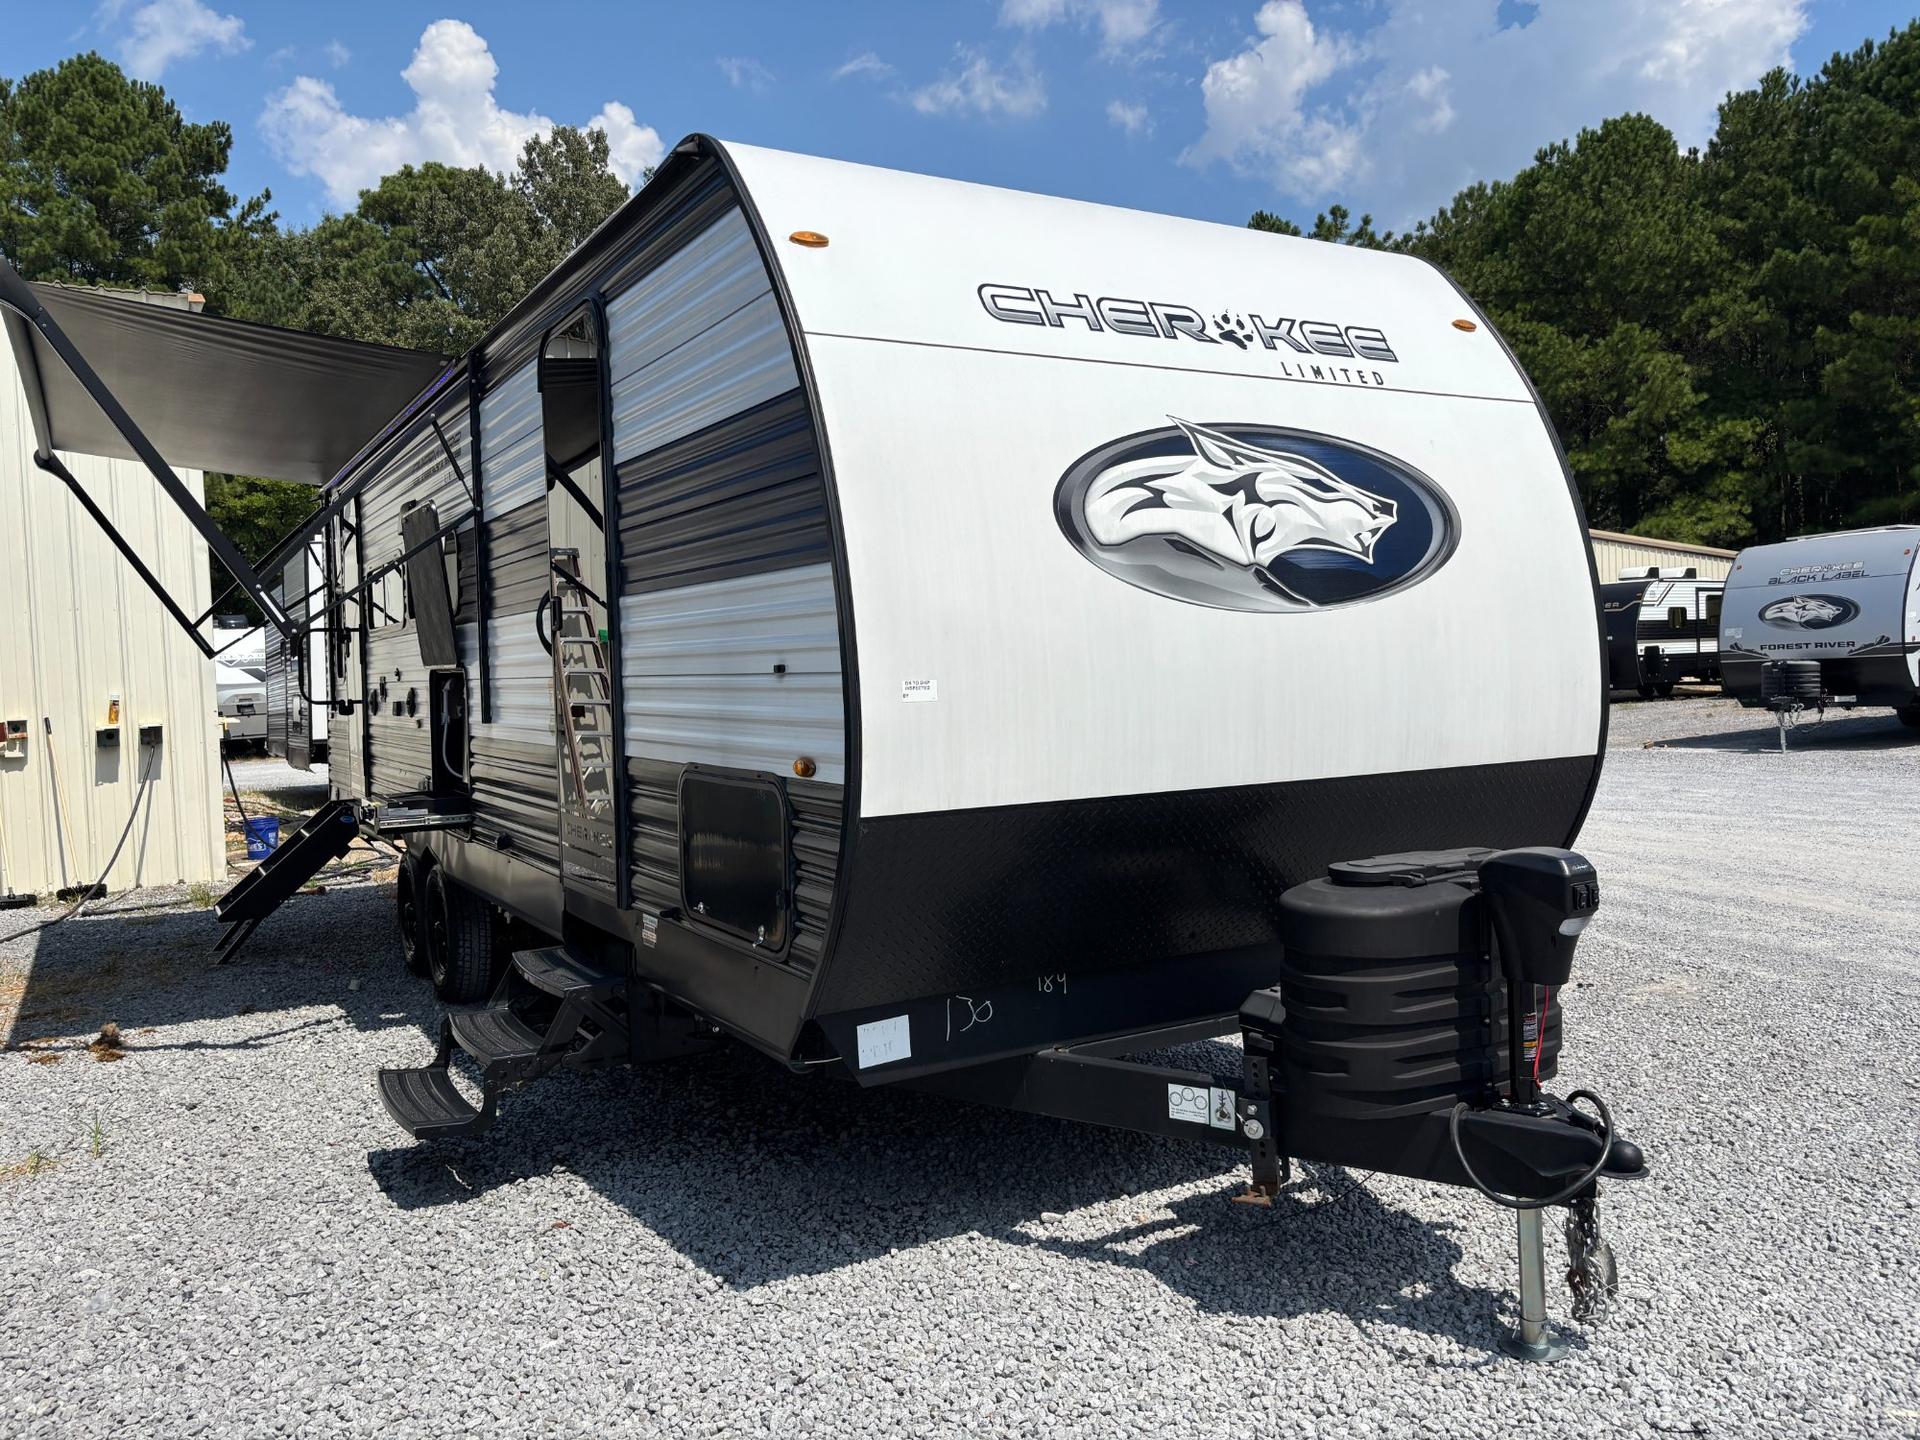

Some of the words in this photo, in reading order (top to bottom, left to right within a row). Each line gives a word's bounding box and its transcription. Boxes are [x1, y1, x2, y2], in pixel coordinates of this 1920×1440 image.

[1280, 361, 1385, 386] LIMITED
[1768, 574, 1817, 585] BLACK
[1821, 570, 1870, 581] LABEL
[1760, 642, 1812, 651] FOREST
[1814, 641, 1856, 649] RIVER
[1038, 972, 1067, 995] 184
